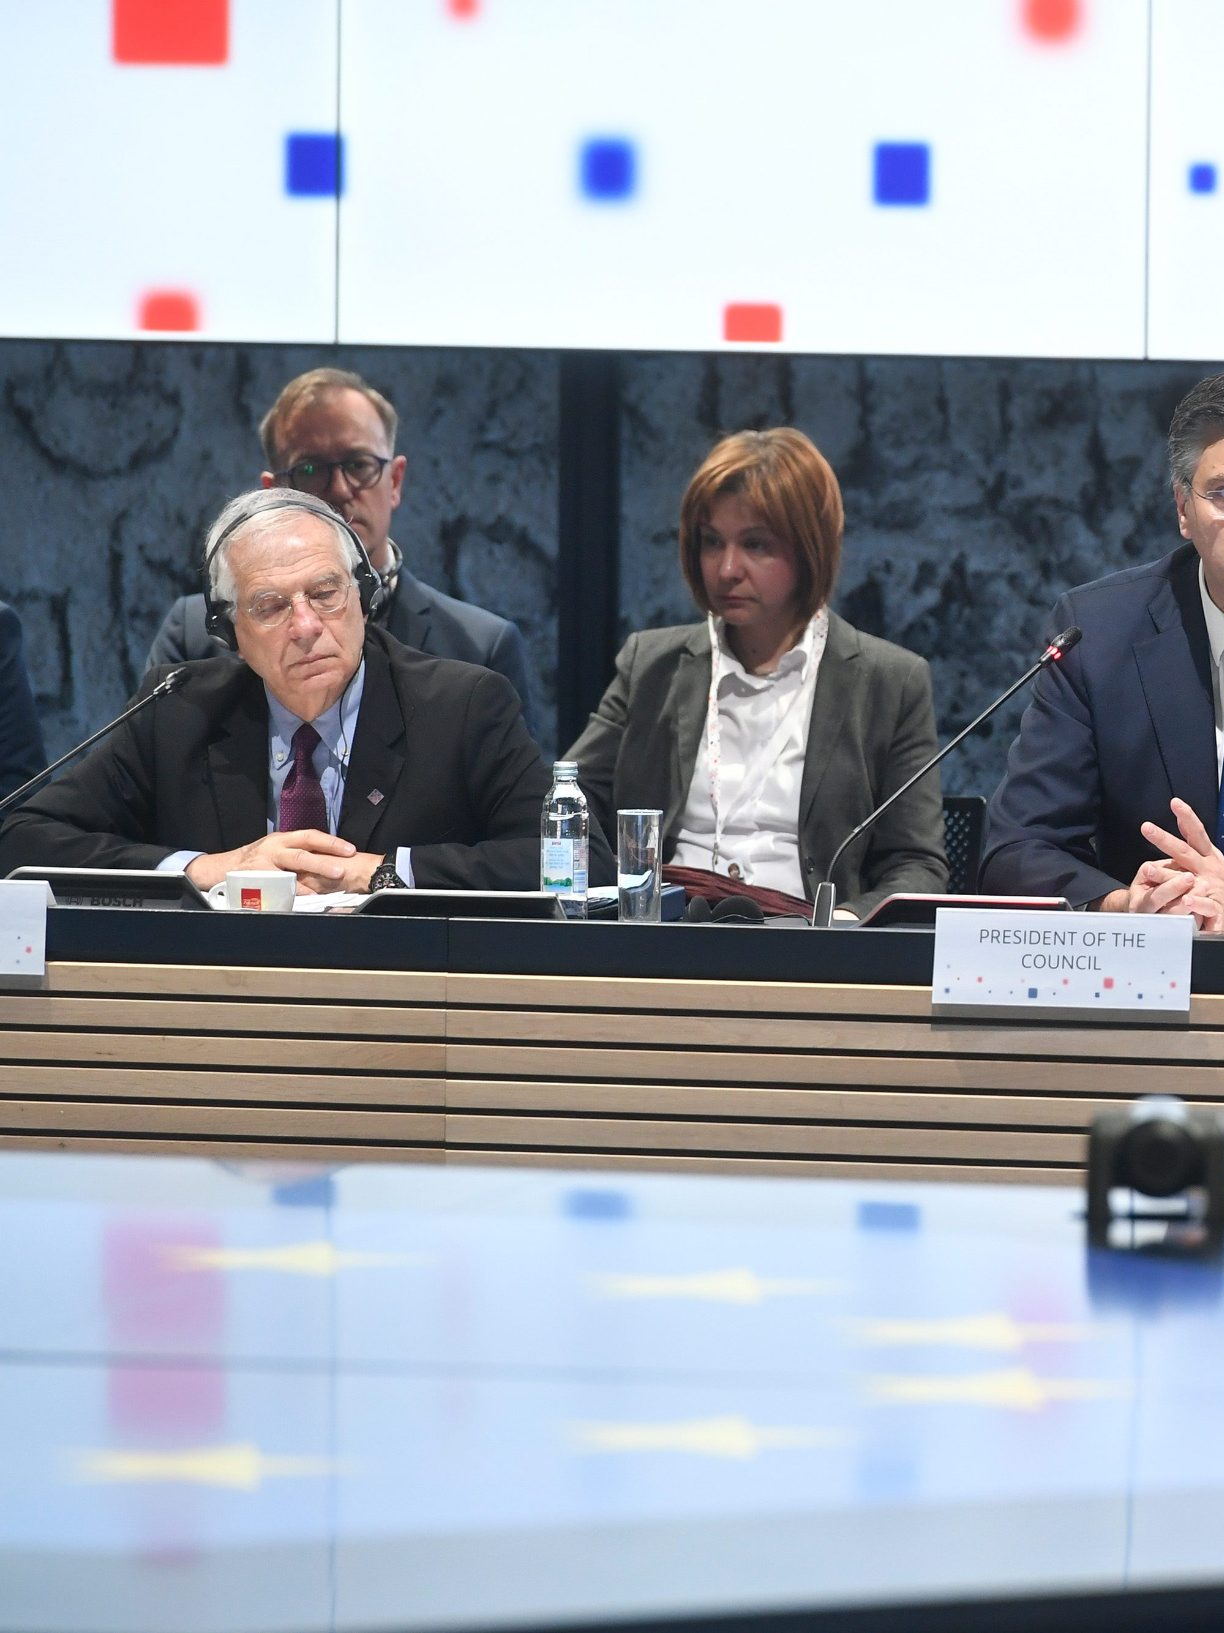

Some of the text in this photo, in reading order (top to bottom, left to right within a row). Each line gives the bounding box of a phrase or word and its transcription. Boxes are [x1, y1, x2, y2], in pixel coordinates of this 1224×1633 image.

[90, 895, 144, 908] BOSCH
[979, 929, 1146, 948] PRESIDENT OF THE
[1021, 953, 1102, 971] COUNCIL
